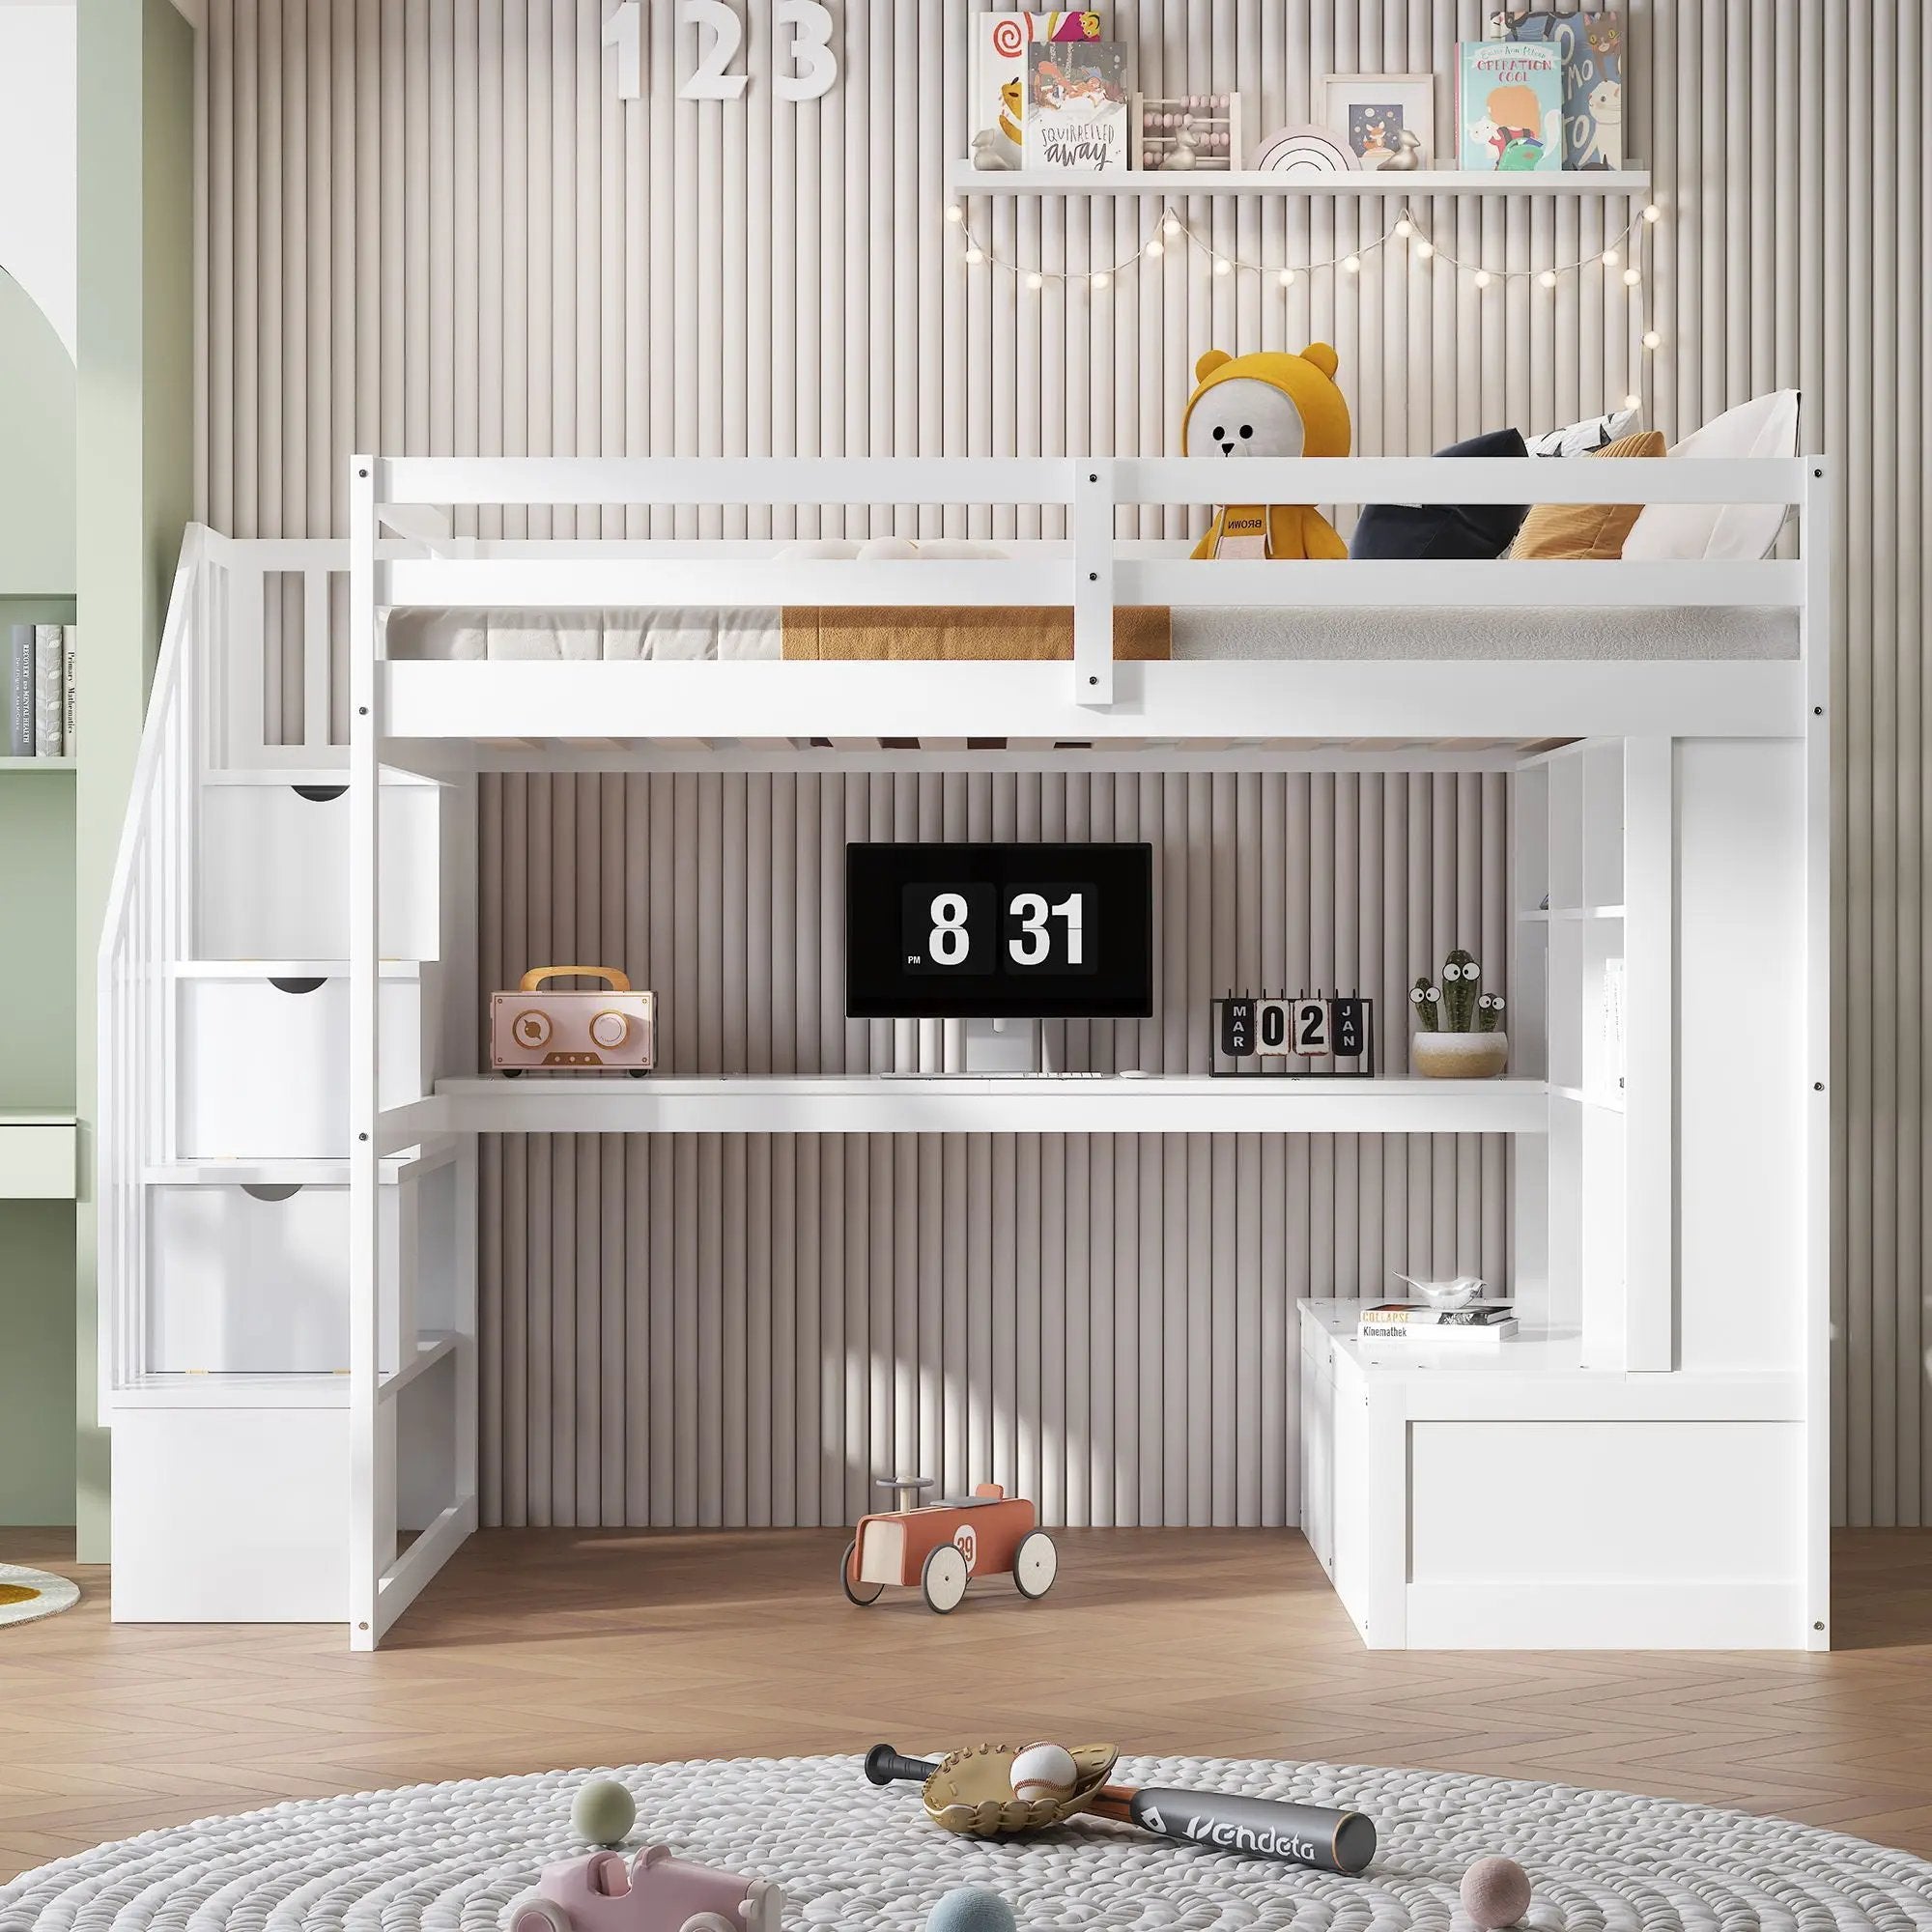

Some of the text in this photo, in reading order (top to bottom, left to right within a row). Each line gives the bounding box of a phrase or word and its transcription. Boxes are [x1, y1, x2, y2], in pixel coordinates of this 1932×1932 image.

[1477, 60, 1551, 71] OPERATION
[1498, 71, 1530, 82] COOL
[1041, 124, 1115, 147] SQUIRRELLED
[1043, 142, 1113, 171] away
[66, 651, 75, 734] Primary Mathematics
[907, 893, 1083, 966] PM 8 31
[1363, 1325, 1407, 1337] Kinemathek
